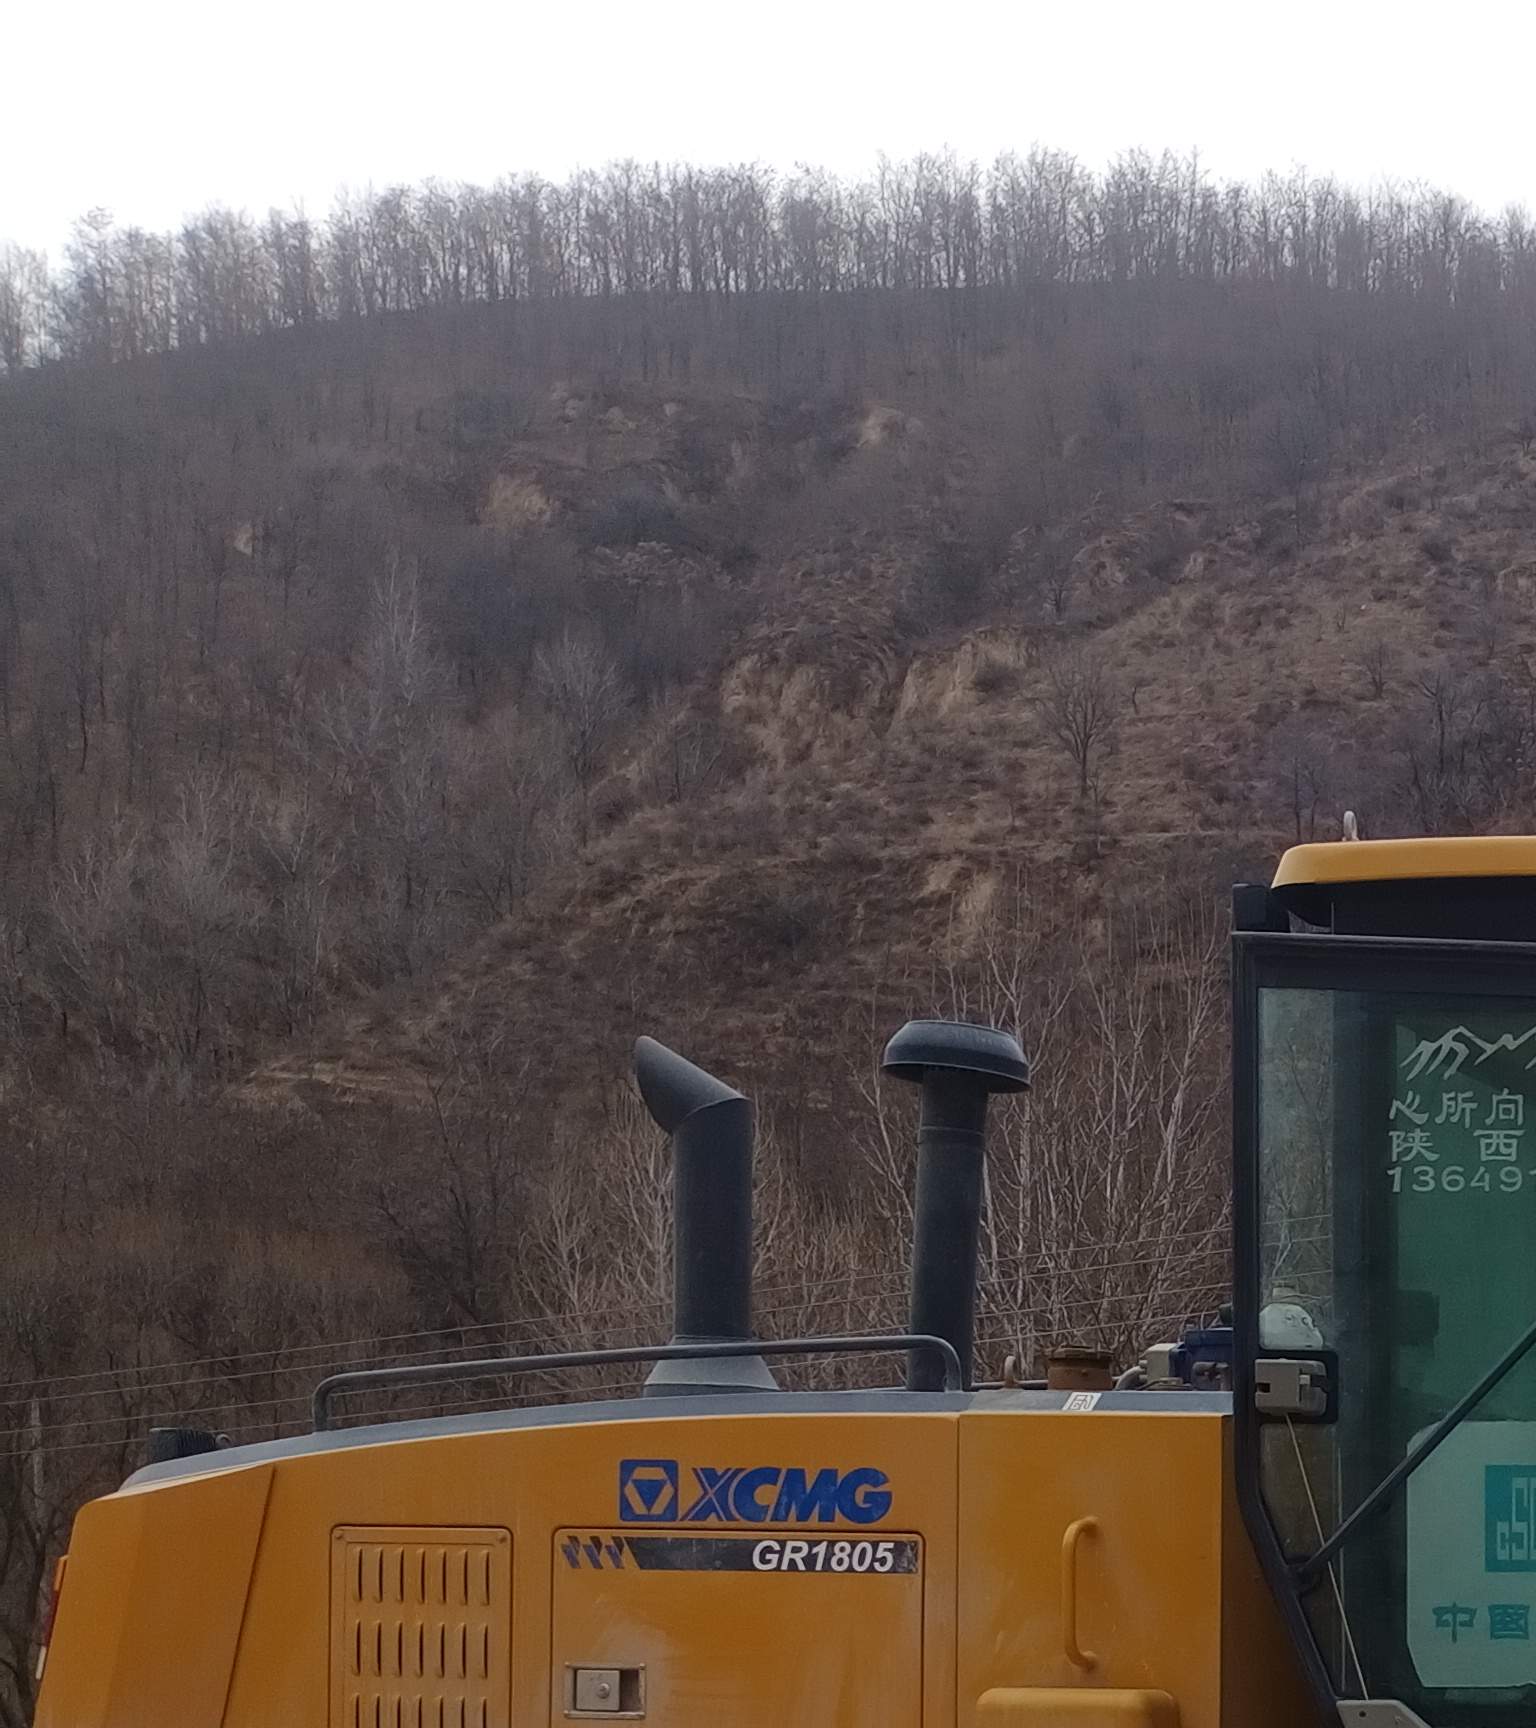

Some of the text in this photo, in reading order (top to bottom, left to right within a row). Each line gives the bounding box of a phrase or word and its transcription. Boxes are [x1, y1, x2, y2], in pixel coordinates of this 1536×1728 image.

[1388, 1088, 1524, 1128] 心所向
[679, 1466, 892, 1524] XCMG
[752, 1540, 895, 1572] GR1805
